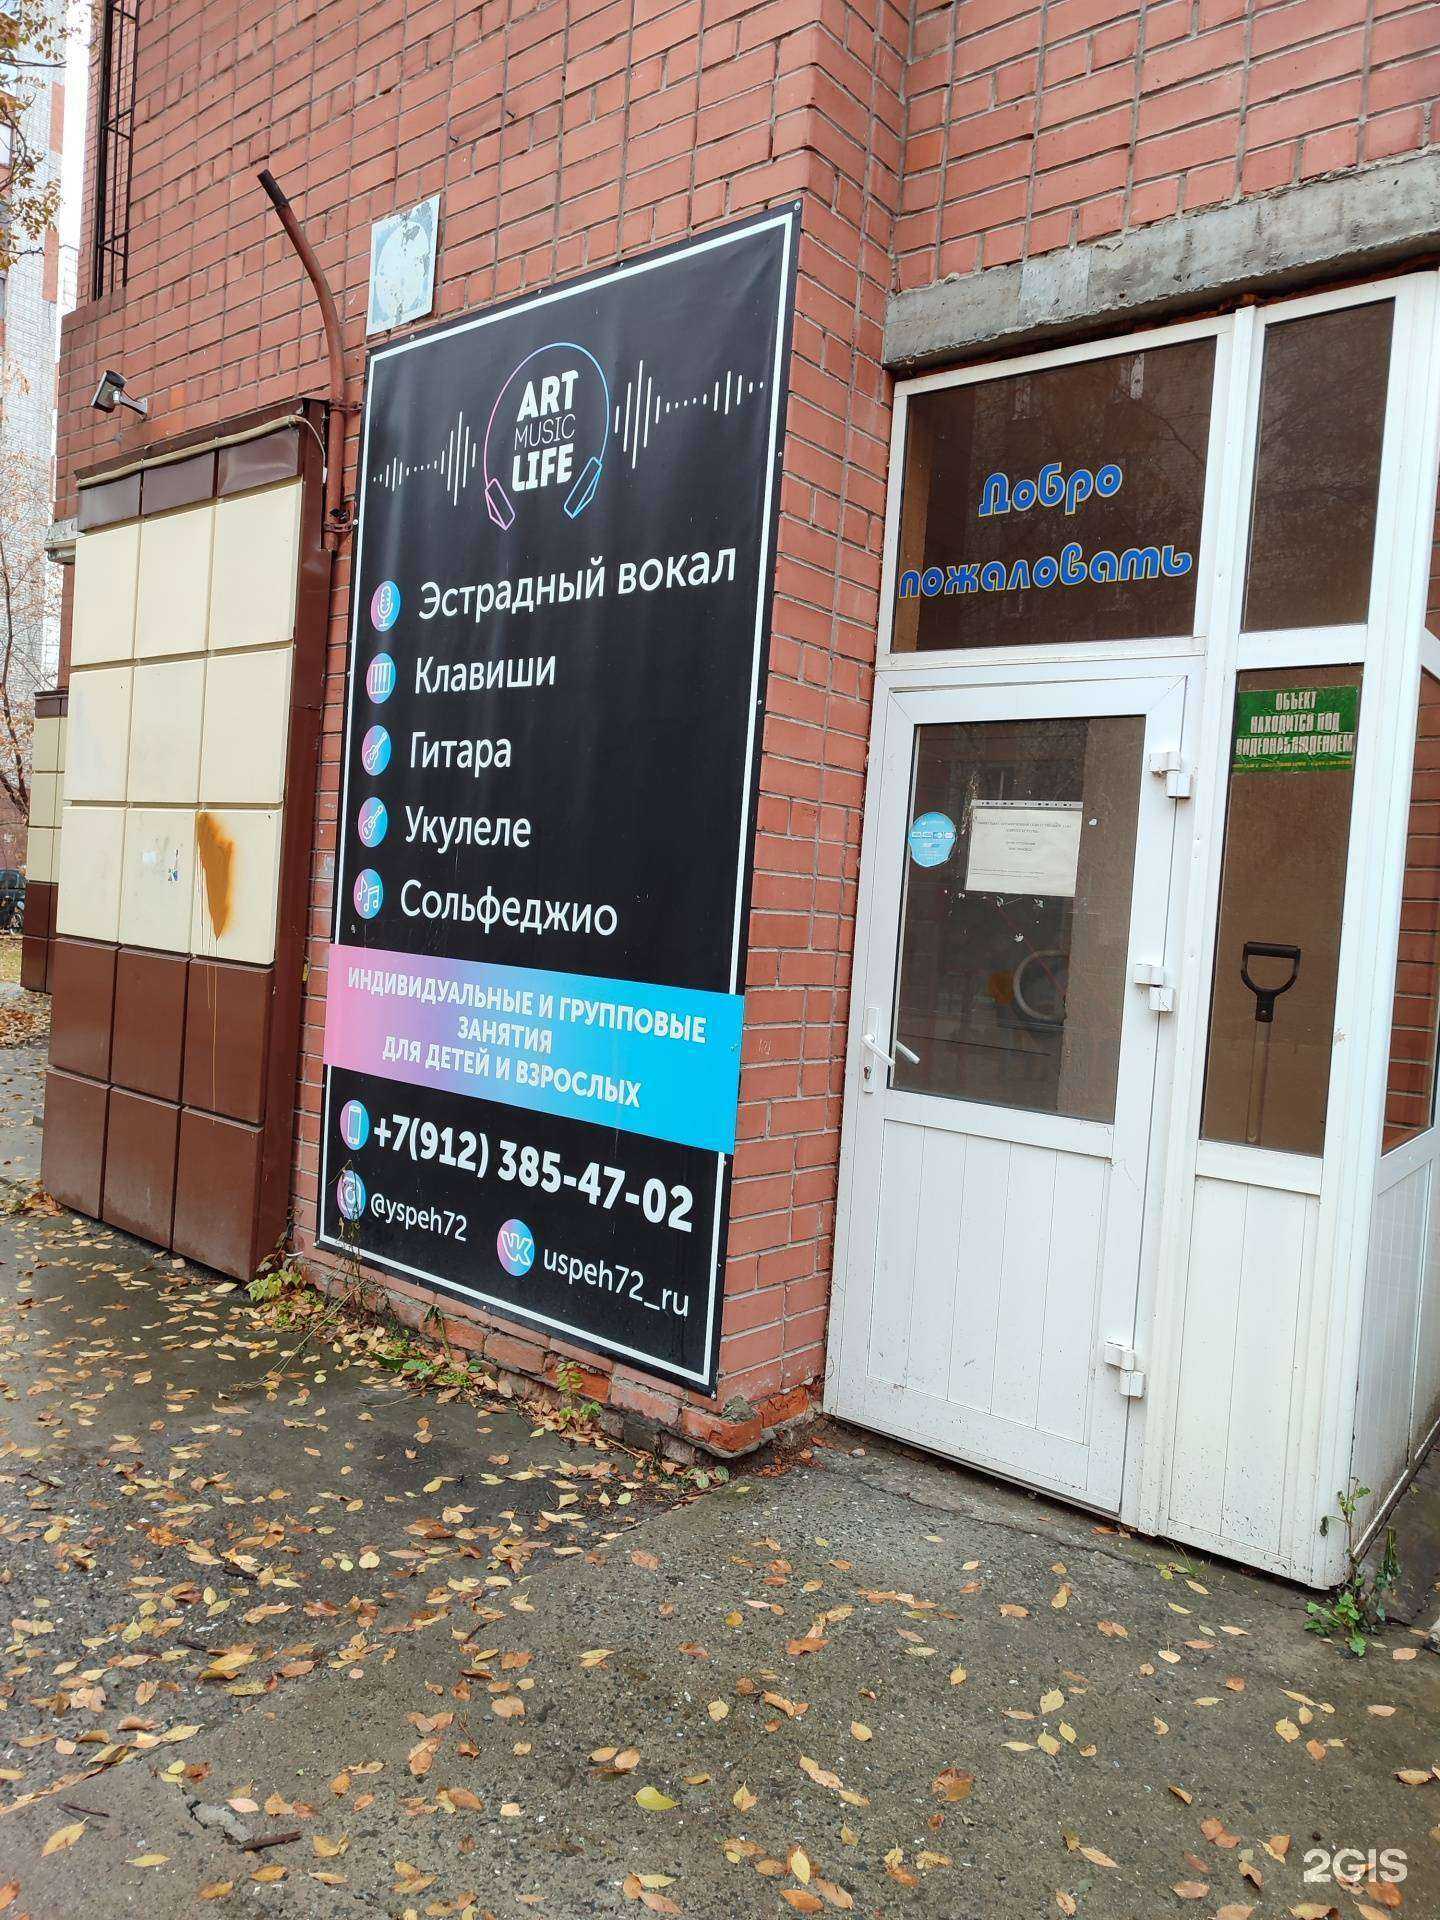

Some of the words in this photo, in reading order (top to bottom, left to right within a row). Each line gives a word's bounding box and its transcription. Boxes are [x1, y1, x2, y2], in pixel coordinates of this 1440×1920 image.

[516, 369, 579, 422] ART
[514, 413, 576, 450] MUSIC
[511, 443, 574, 492] LIFE
[978, 462, 1123, 517] Добро
[417, 556, 604, 623] Эстрадный
[618, 547, 736, 595] вокал
[898, 542, 1193, 599] пожаловать
[415, 655, 557, 694] Клавиши
[1250, 714, 1314, 734] НАХОДИТСЯ
[1317, 713, 1340, 732] ПОД
[1275, 691, 1317, 710] ОБЪЕКТ
[410, 731, 512, 778] Гитара
[404, 805, 532, 854] Укулеле
[400, 879, 618, 937] Сольфеджио
[347, 966, 532, 1017] ИНДИВИДУАЛЬНЫЕ
[538, 993, 553, 1019] И
[559, 996, 707, 1044] ГРУППОВЫЕ
[457, 1016, 552, 1054] ЗАНЯТИЯ
[382, 1035, 421, 1068] ДЛЯ
[425, 1041, 489, 1077] ДЕТЕЙ
[494, 1053, 510, 1080] И
[516, 1061, 642, 1108] ВЗРОСЛЫХ
[373, 1113, 489, 1178] +7(912)
[497, 1139, 693, 1233] 385-47-02
[370, 1192, 467, 1242] @yspeh72
[543, 1248, 690, 1317] uspeh72_ru
